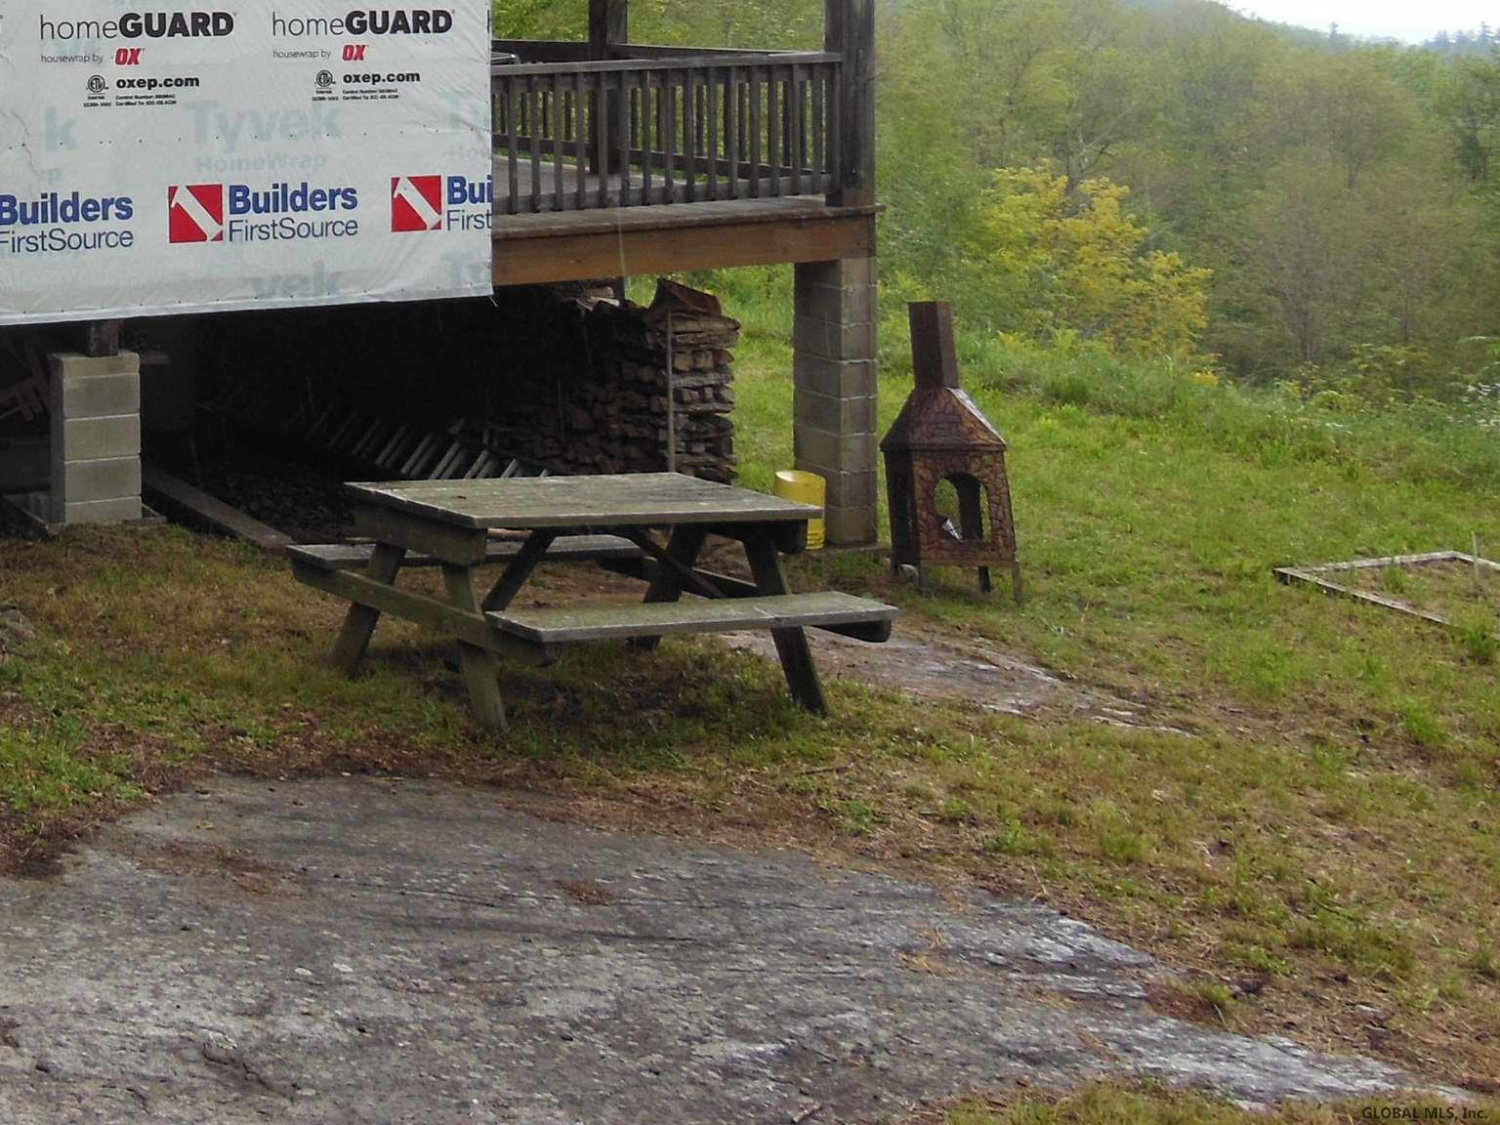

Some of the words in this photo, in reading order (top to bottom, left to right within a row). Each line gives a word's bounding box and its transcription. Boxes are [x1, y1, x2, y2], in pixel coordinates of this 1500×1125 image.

[40, 12, 234, 39] homeGUARD
[272, 9, 453, 36] homeGUARD
[92, 52, 104, 63] by
[115, 48, 141, 65] OX
[320, 49, 331, 59] by
[342, 44, 366, 61] OX
[116, 77, 199, 90] oxep.com
[343, 71, 420, 85] oxep.com
[228, 182, 357, 215] Builders
[228, 217, 357, 242] FirstSource
